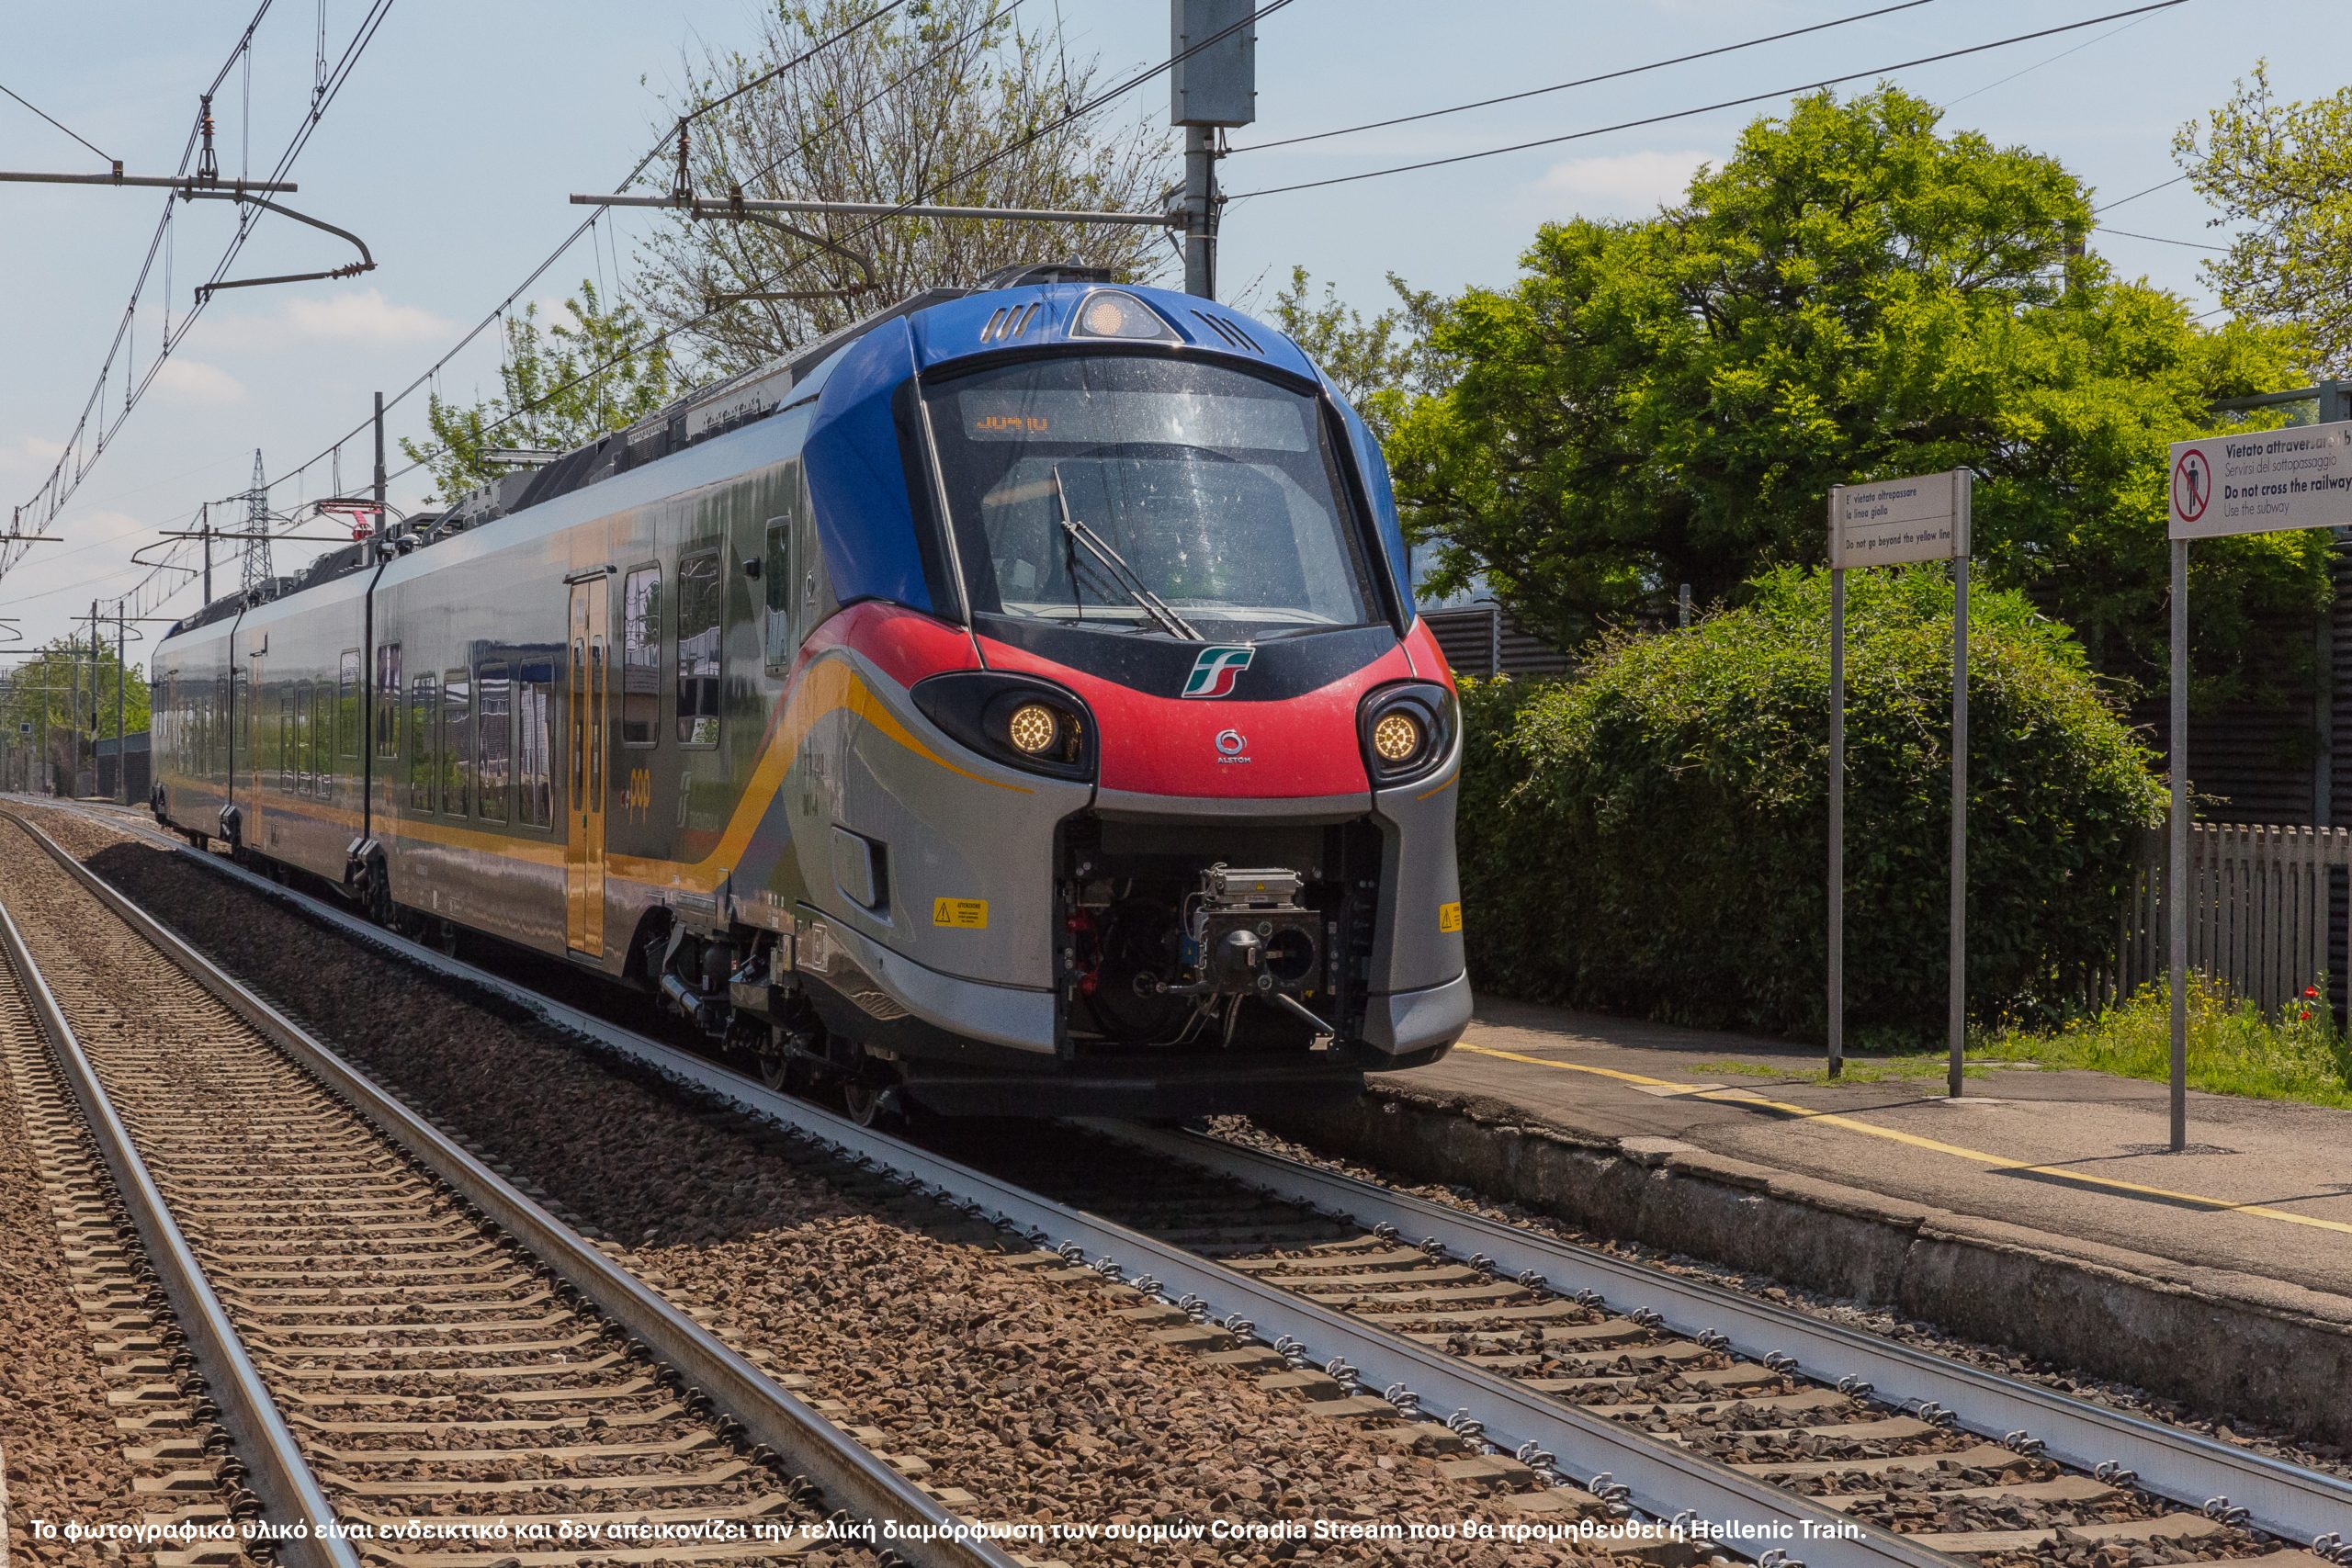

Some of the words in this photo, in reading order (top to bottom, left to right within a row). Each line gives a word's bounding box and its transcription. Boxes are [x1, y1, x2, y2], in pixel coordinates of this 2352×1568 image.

[2225, 444, 2264, 458] Vietato
[2266, 437, 2334, 455] attraverar
[2225, 462, 2256, 477] Servirsi
[2256, 458, 2270, 473] del
[2272, 453, 2337, 474] sottopassaggio
[1854, 492, 1875, 504] vietato
[1878, 488, 1917, 502] oltrepassare
[2224, 485, 2239, 500] Do
[2242, 484, 2258, 498] not
[2261, 483, 2288, 496] cross
[2290, 477, 2308, 493] the
[2310, 474, 2352, 492] railway
[1846, 509, 1852, 520] la
[1854, 507, 1869, 518] linea
[1871, 504, 1888, 519] gialla
[2223, 504, 2239, 517] Use
[2242, 502, 2255, 515] the
[2256, 500, 2290, 515] subway
[1846, 539, 1854, 549] Do
[1856, 539, 1866, 548] not
[1868, 538, 1876, 550] go
[1878, 533, 1902, 548] beyond
[1903, 532, 1914, 543] the
[1916, 530, 1937, 545] yellow
[1939, 529, 1951, 539] line
[629, 768, 650, 824] pop
